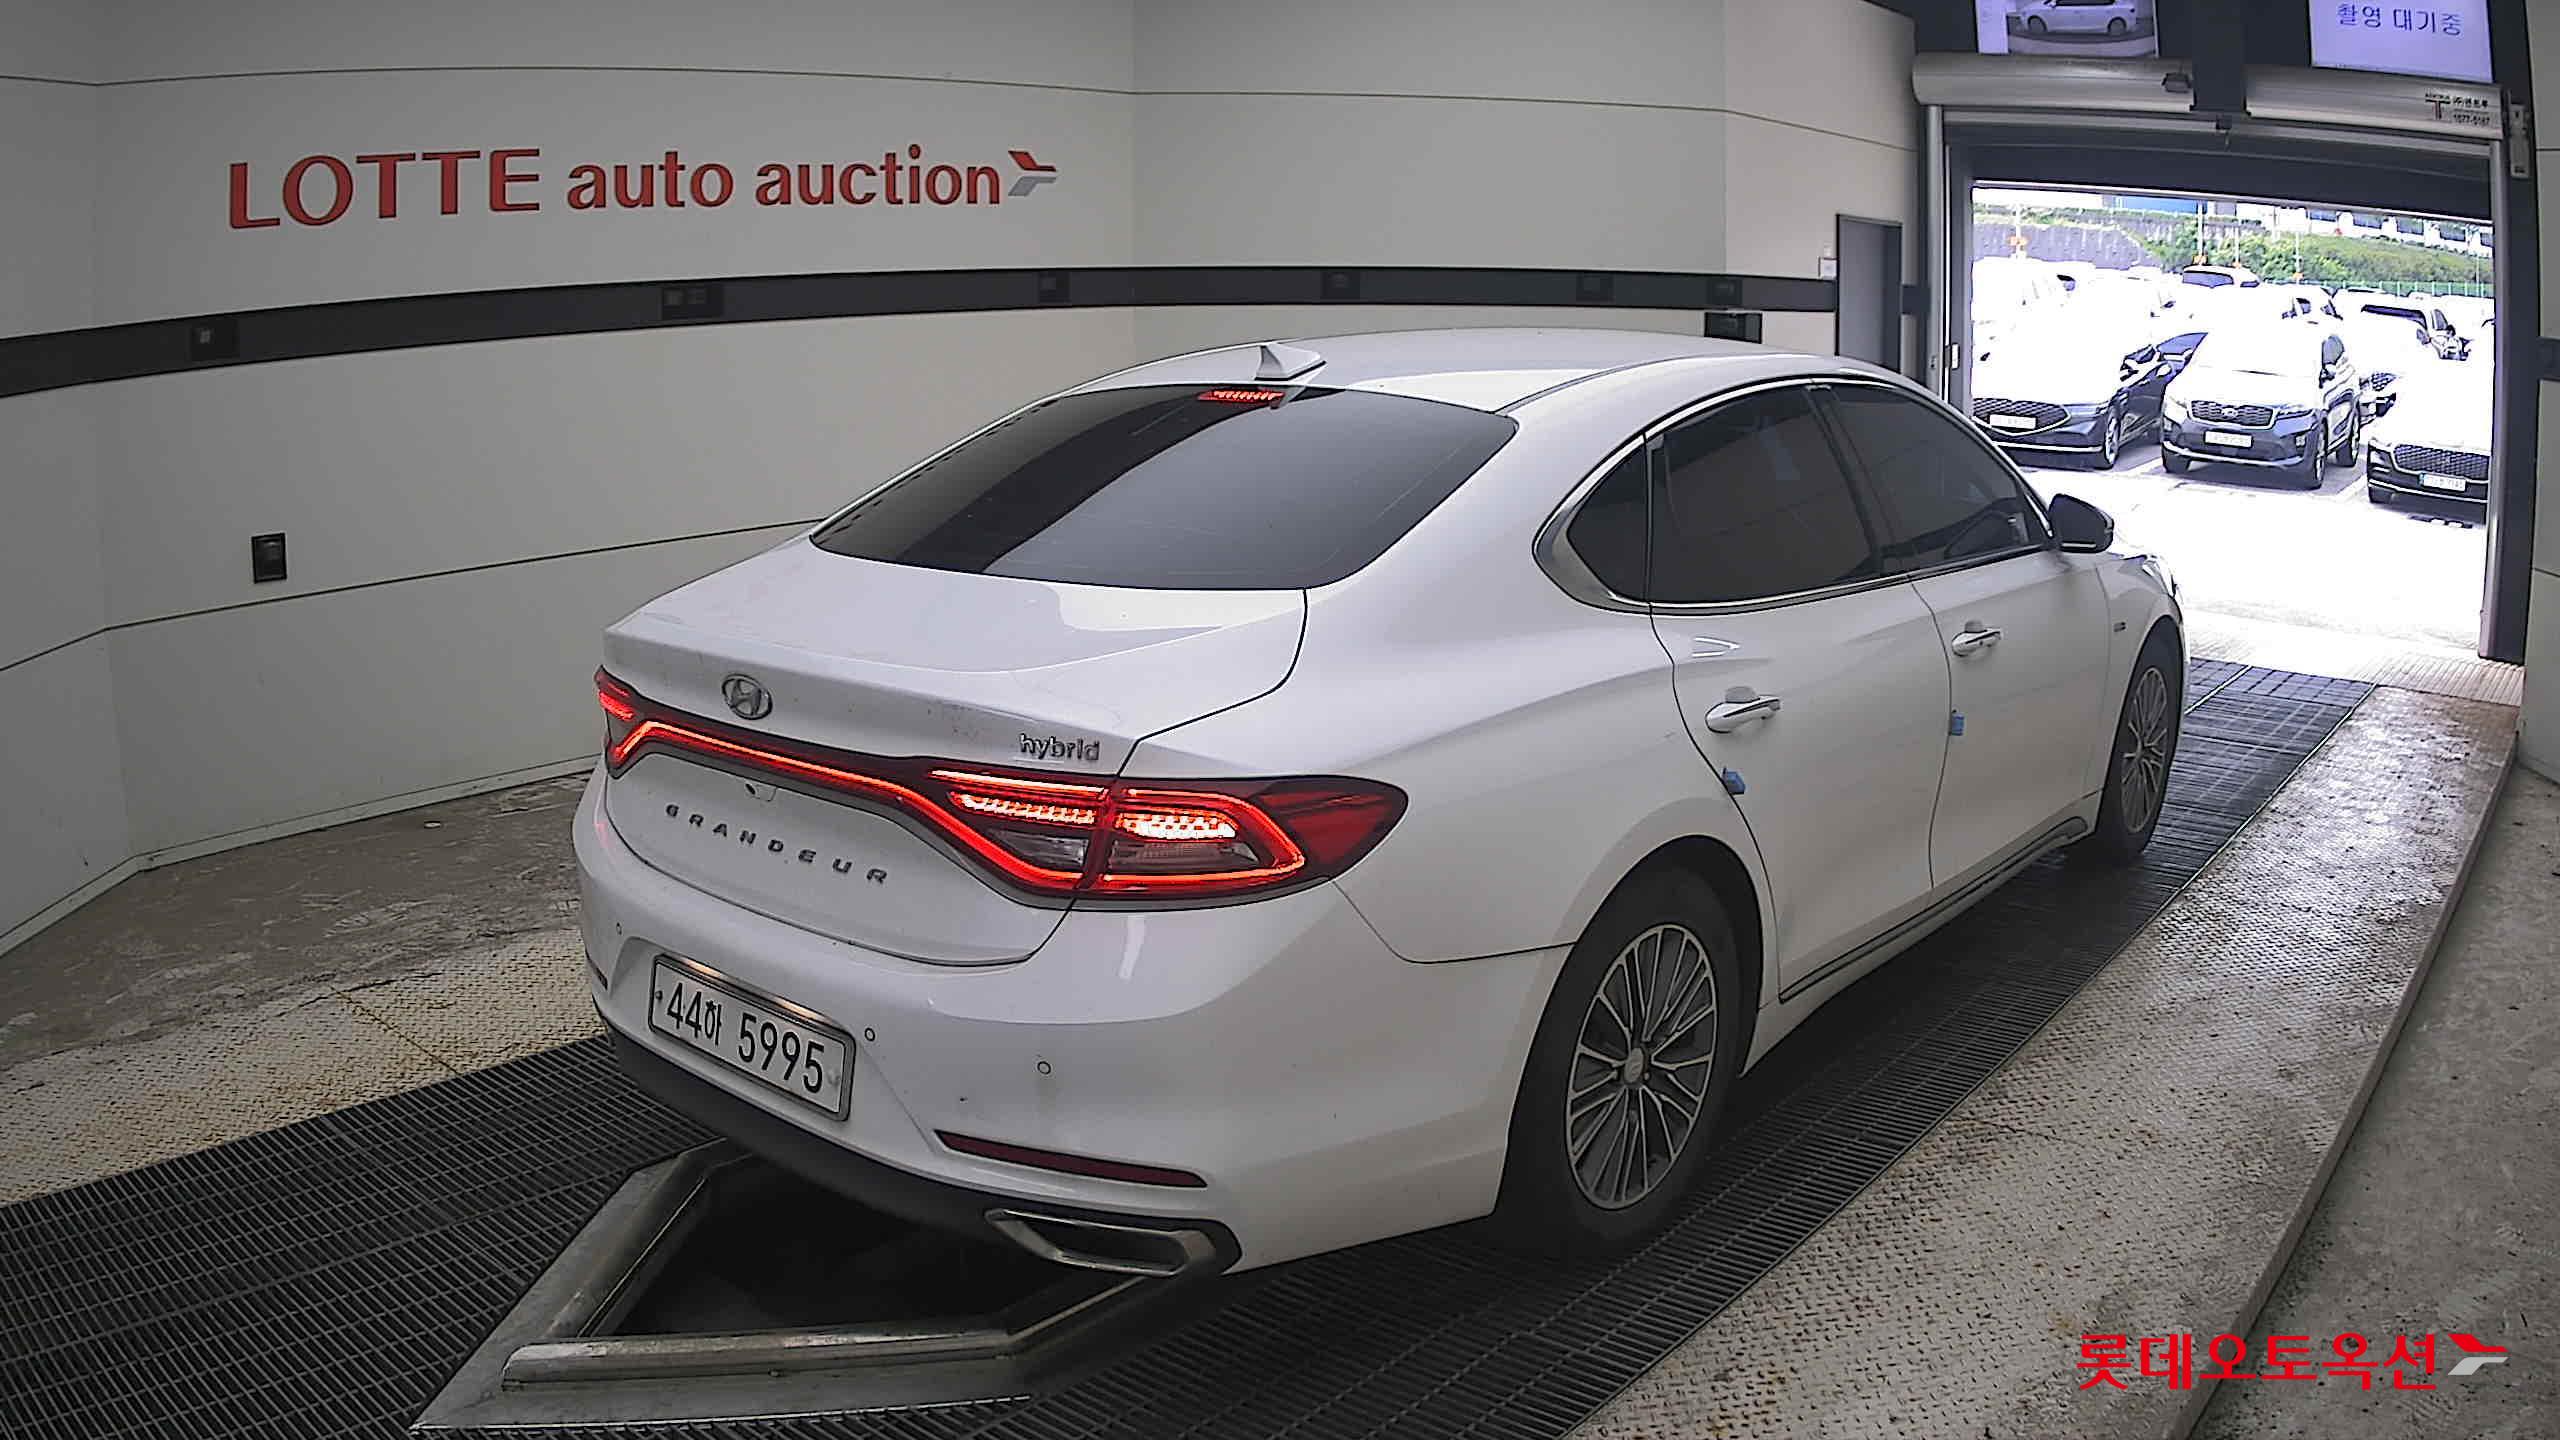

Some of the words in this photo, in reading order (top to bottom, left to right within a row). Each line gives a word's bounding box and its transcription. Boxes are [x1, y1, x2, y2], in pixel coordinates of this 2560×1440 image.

[2338, 3, 2382, 29] 촬영
[2392, 8, 2462, 36] 대기중
[229, 148, 540, 229] LOTTE
[566, 150, 734, 209] auto
[755, 143, 1001, 206] auction
[1019, 732, 1100, 761] hybrid
[665, 803, 888, 884] GRANDEUR
[666, 982, 723, 1046] 44하
[737, 1011, 825, 1094] 5995
